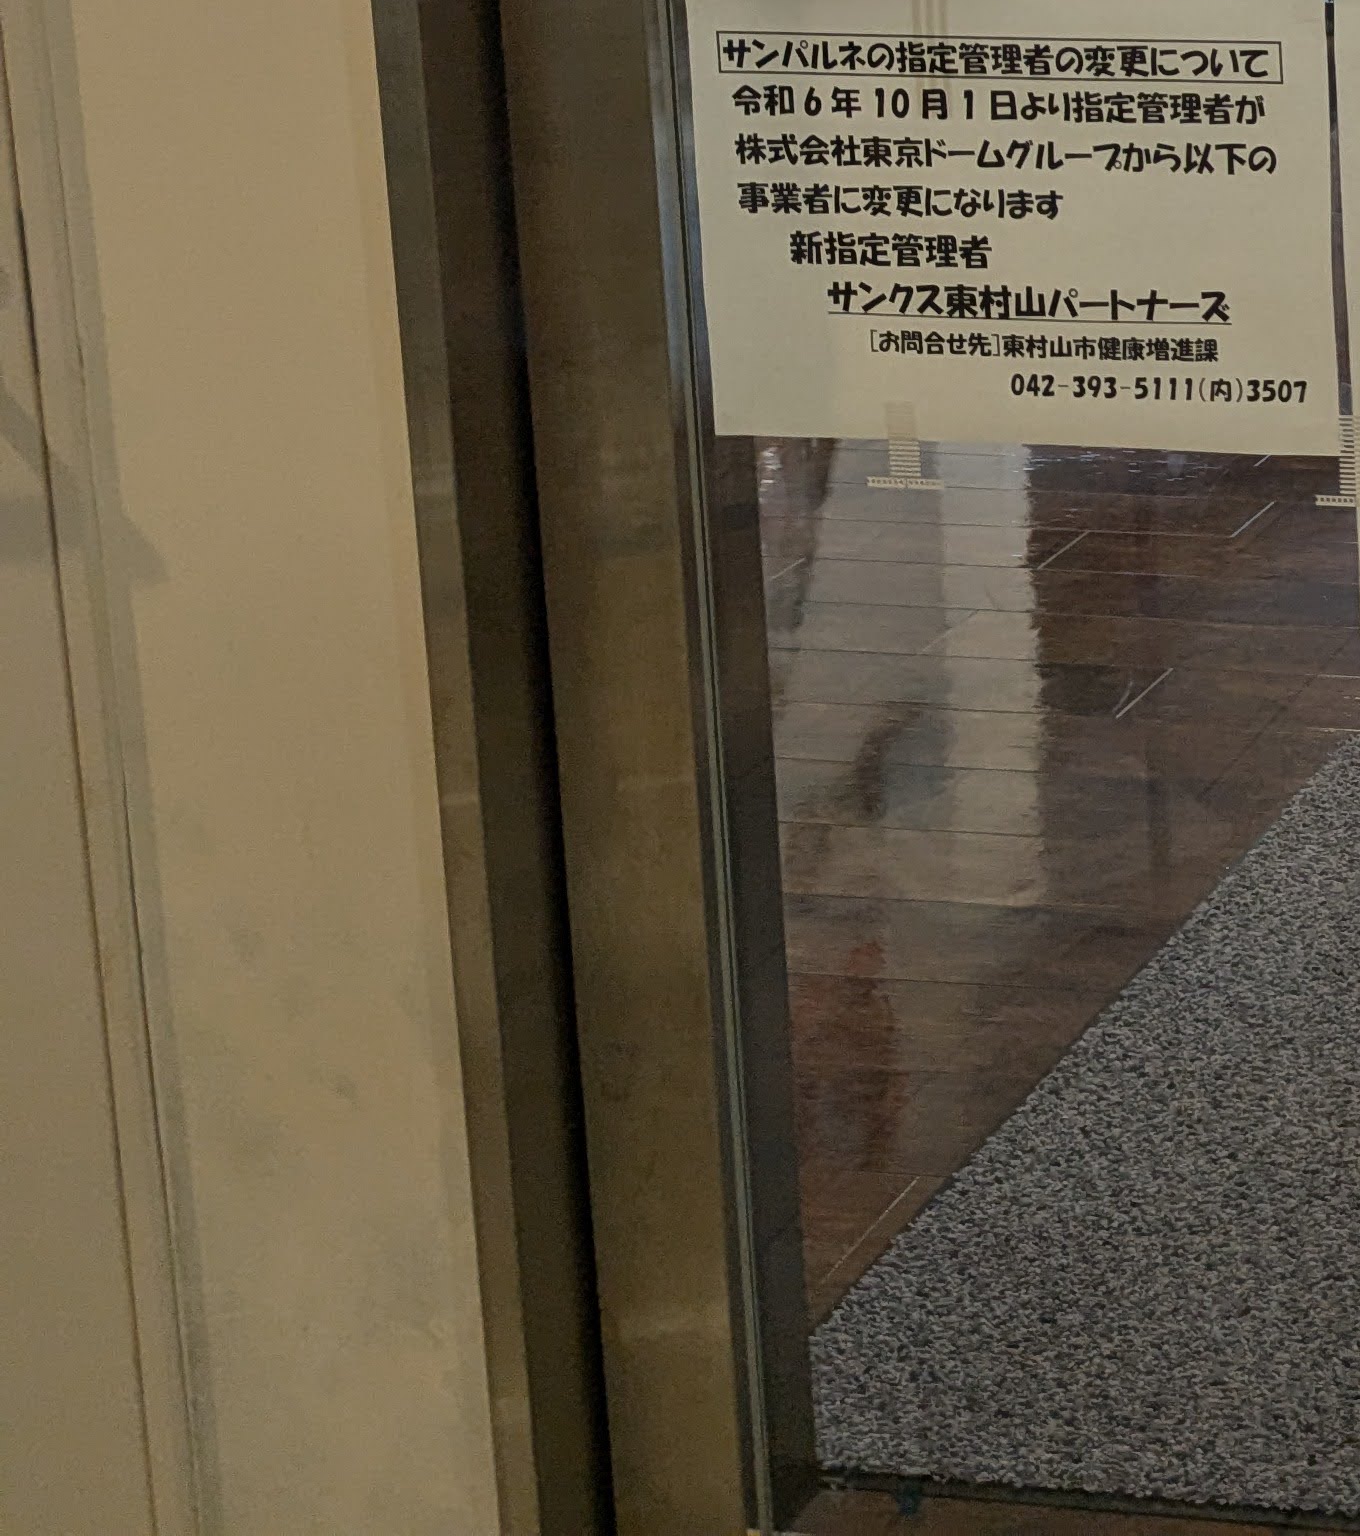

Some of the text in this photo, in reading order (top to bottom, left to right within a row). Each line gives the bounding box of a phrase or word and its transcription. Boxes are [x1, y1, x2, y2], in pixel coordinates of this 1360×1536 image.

[722, 38, 1270, 78] サンパルネの指定管理者の変更について
[731, 84, 1266, 125] 令和6年10月1日より指定管理者が
[734, 134, 1277, 176] 株式会社東京ドームグループから以下の
[737, 181, 1064, 220] 事業者に変更になります
[789, 231, 993, 270] 新指定管理者
[827, 280, 1231, 322] サンクス東村山パートナーズ
